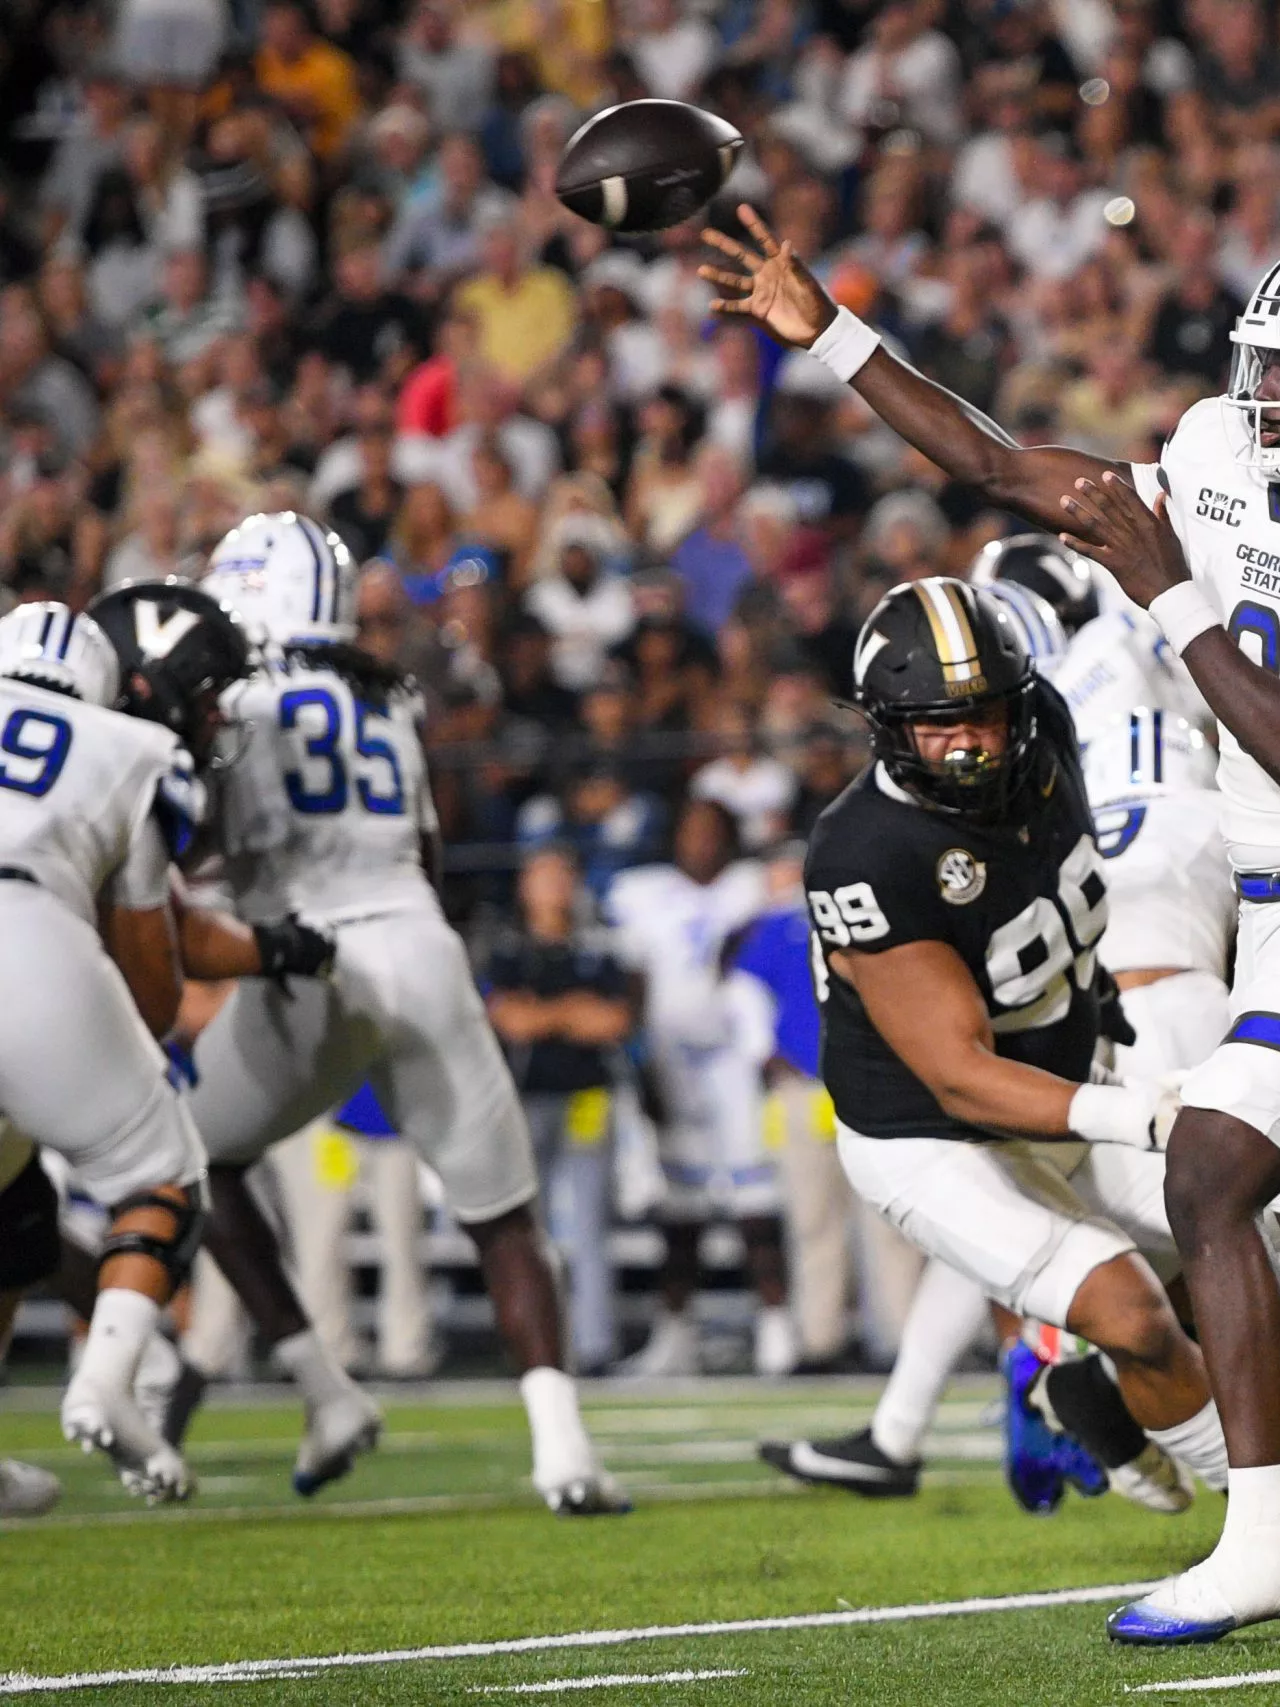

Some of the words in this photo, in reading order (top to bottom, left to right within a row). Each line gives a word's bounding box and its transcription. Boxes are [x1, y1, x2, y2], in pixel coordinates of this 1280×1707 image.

[0, 709, 72, 798] 9
[279, 688, 405, 815] 35
[808, 881, 891, 947] 99
